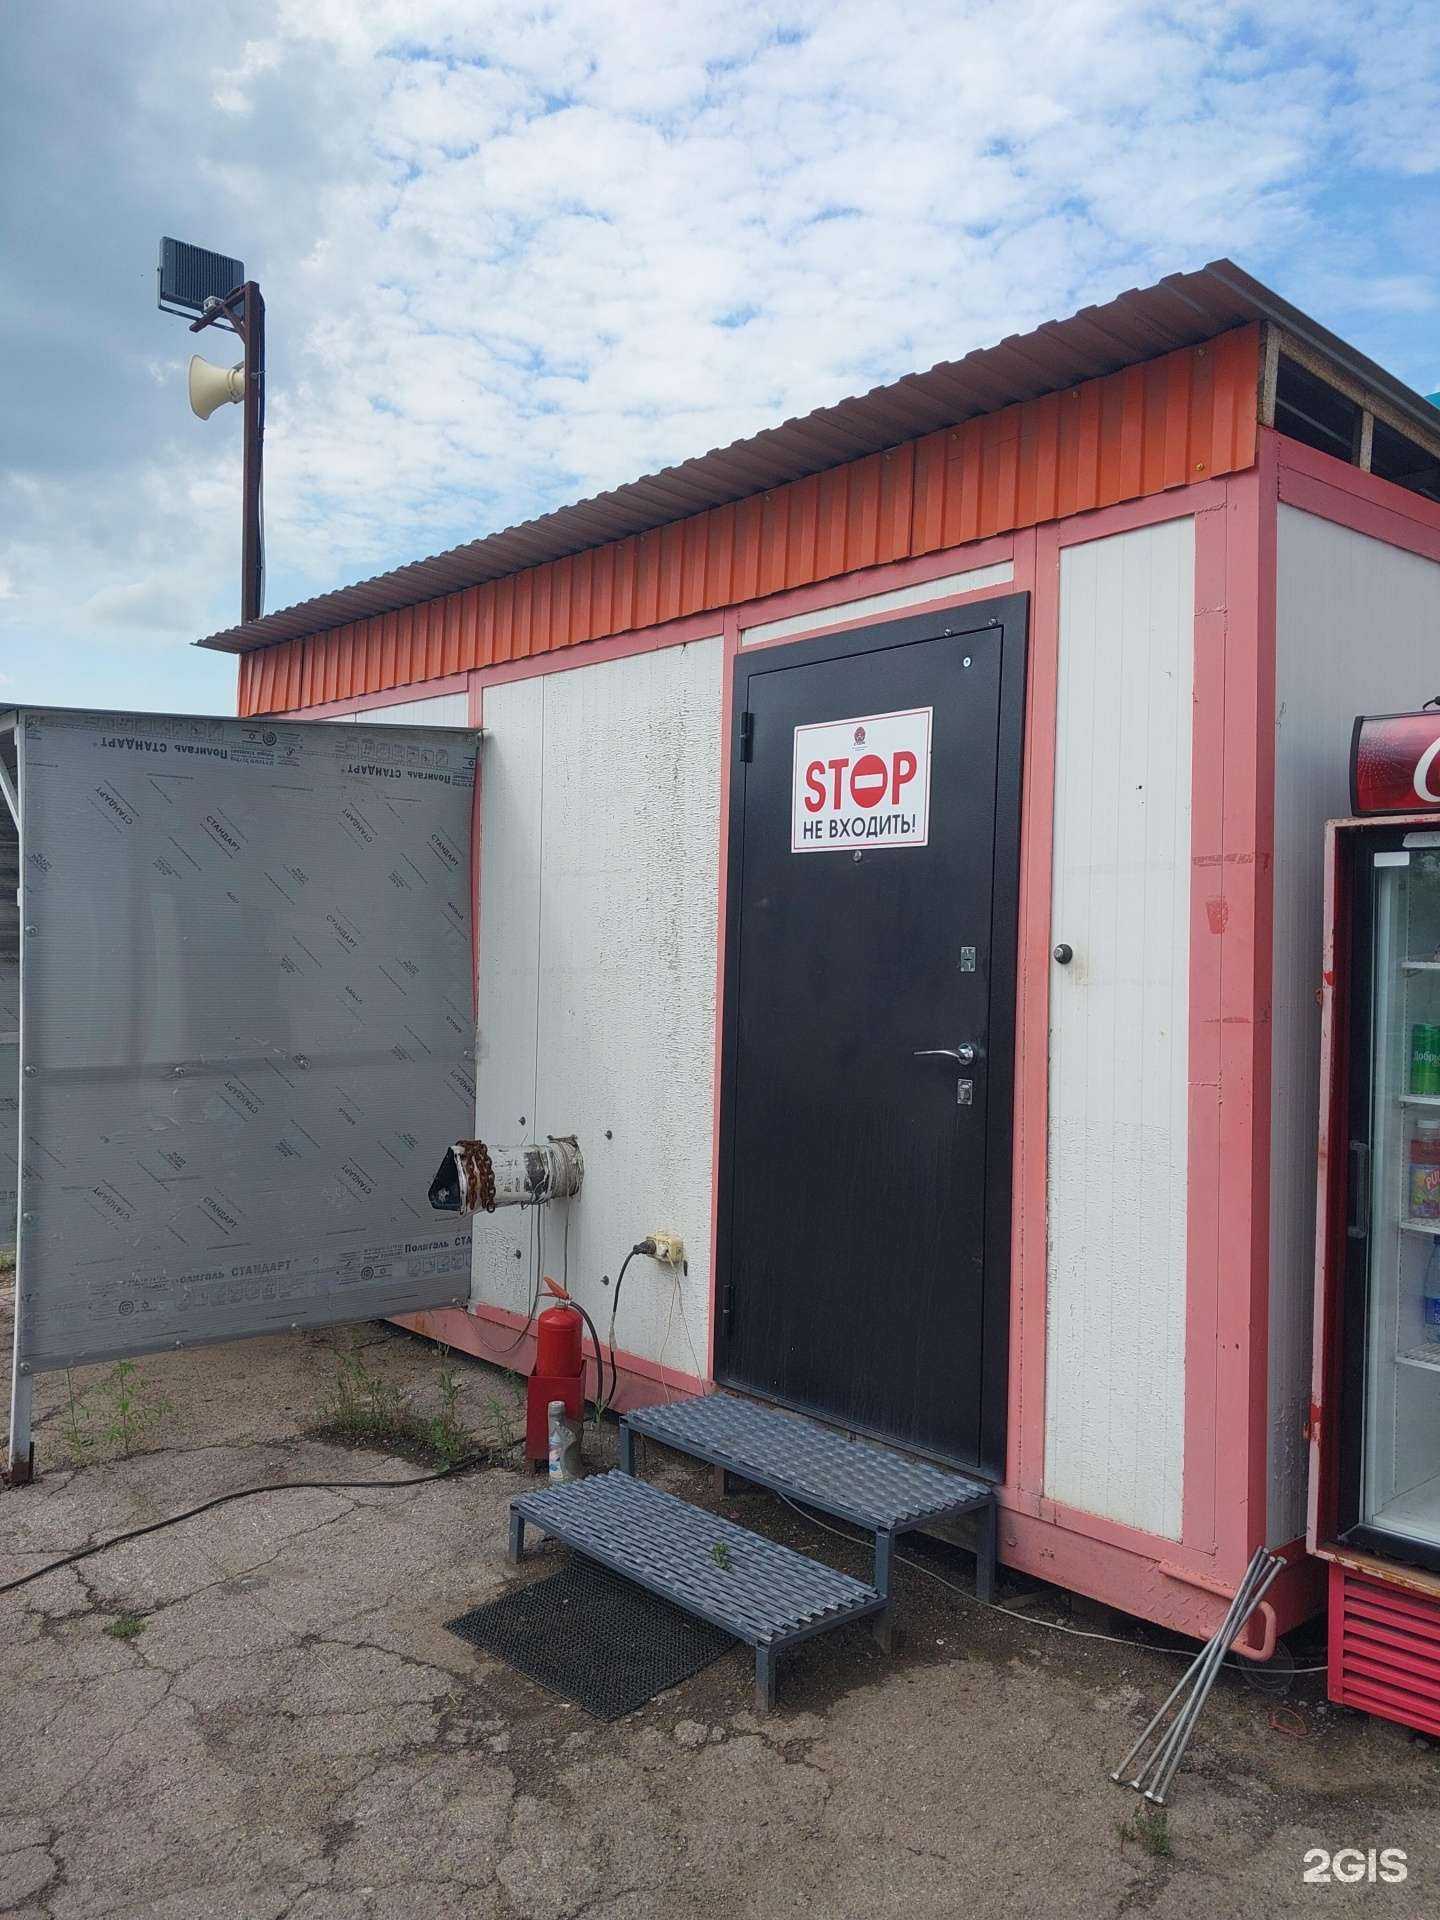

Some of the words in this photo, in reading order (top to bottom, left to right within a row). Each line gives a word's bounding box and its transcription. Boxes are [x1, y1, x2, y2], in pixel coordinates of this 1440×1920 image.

[100, 736, 168, 753] СТАНДАРТ
[174, 744, 228, 760] Полигаль
[347, 763, 402, 779] СТАНДАРТ
[407, 771, 451, 784] Полигаль
[804, 750, 918, 813] STOP
[95, 785, 133, 826] СТАНДАРТ
[206, 815, 241, 852] СТАНДАРТ
[341, 808, 373, 844] СТАНДАРТ
[803, 819, 824, 840] НЕ
[828, 813, 917, 839] ВХОДИТЬ!
[431, 833, 459, 867] СТАНДАРТ
[326, 914, 359, 948] СТАНДАРТ
[341, 1164, 373, 1195] СТАНДАРТ
[202, 1195, 239, 1229] СТАНДАРТ
[404, 1241, 450, 1254] Полигаль
[230, 1259, 293, 1278] СТАНДАРТ
